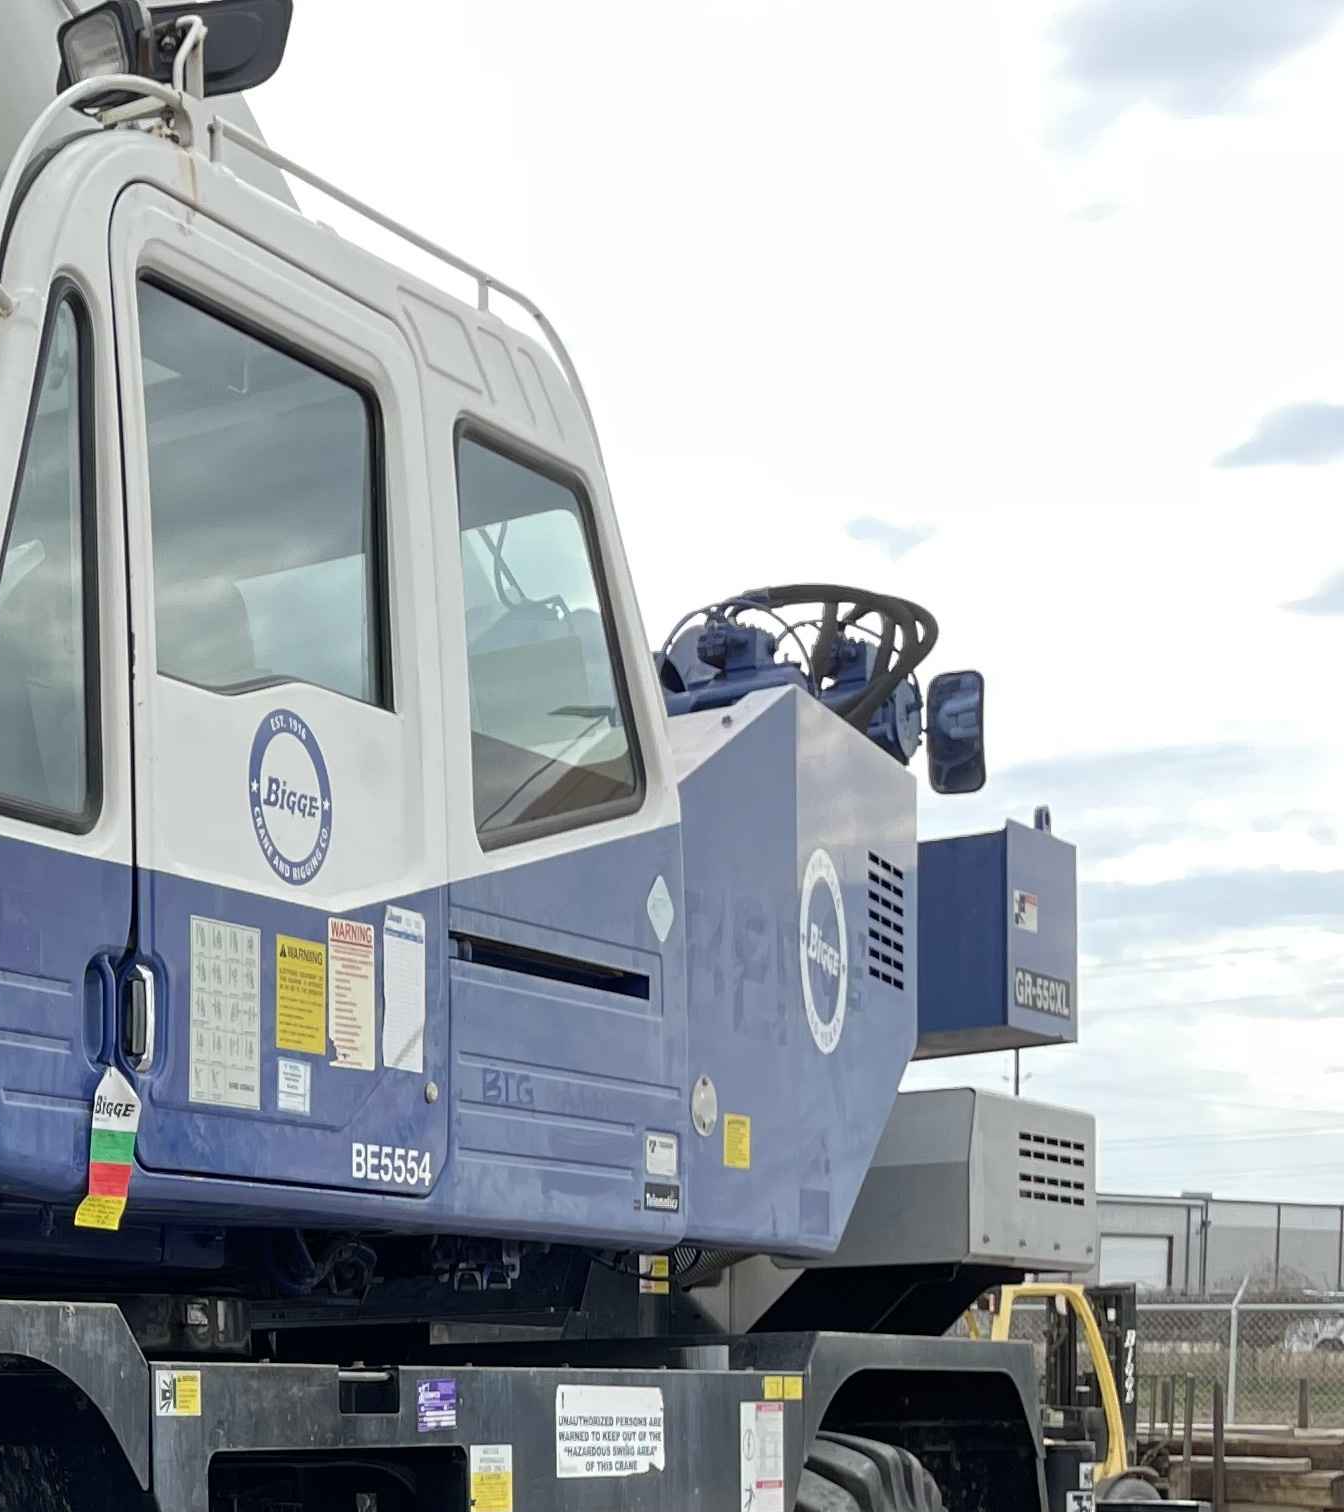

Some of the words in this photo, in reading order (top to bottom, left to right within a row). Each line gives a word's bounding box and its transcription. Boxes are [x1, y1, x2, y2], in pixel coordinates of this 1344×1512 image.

[270, 715, 288, 731] EST.
[272, 855, 291, 878] AND
[330, 918, 373, 943] WARNING
[287, 944, 324, 967] WARNING
[352, 1142, 432, 1187] BE5554
[558, 1415, 614, 1427] UNAUTHORIZED
[615, 1415, 648, 1427] PERSONS
[558, 1431, 590, 1442] WARNED
[591, 1431, 601, 1442] TO
[602, 1431, 621, 1442] KEEP
[622, 1431, 637, 1442] OUT
[637, 1431, 647, 1442] OF
[648, 1431, 662, 1443] THE
[585, 1461, 595, 1472] OF
[596, 1461, 613, 1472] THIS
